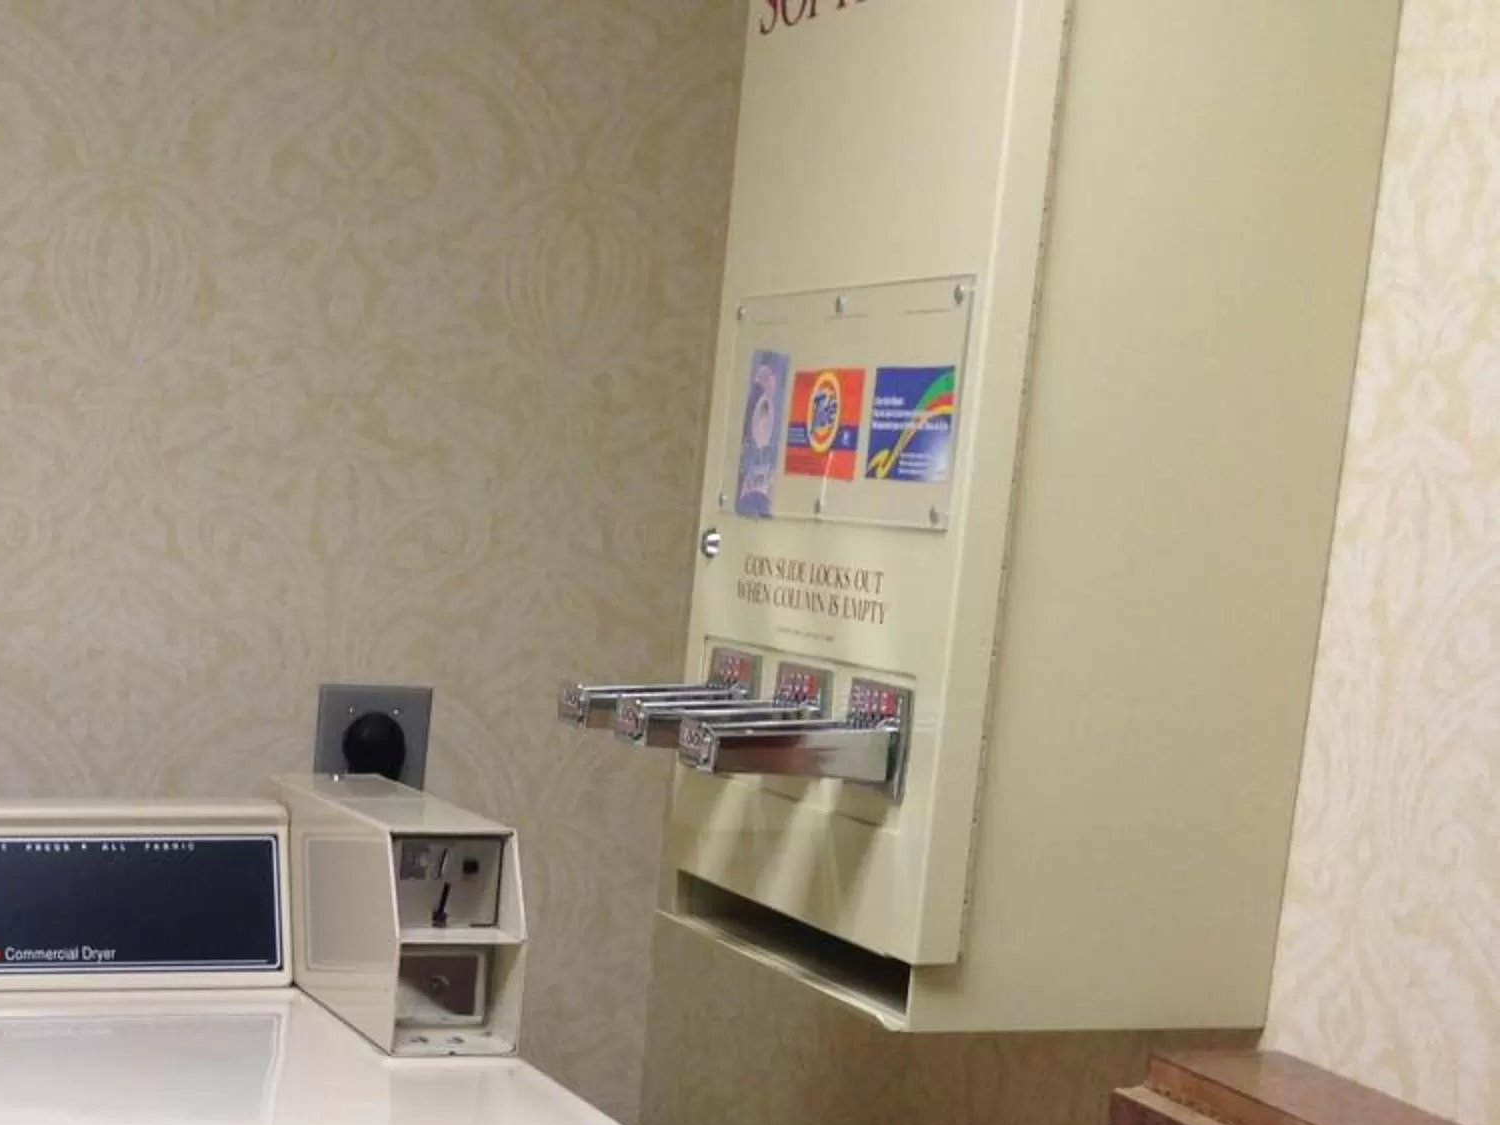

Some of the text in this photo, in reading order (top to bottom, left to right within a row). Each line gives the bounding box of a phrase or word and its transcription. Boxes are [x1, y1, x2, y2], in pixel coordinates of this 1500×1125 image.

[744, 555, 885, 595] COIN SLIDE LOCKS OUT
[737, 579, 886, 625] WHEN COLUMN IS EMPTY
[25, 843, 71, 853] PRESS
[102, 842, 128, 852] ALL
[4, 945, 79, 961] Commercial
[82, 945, 116, 964] Dryer
